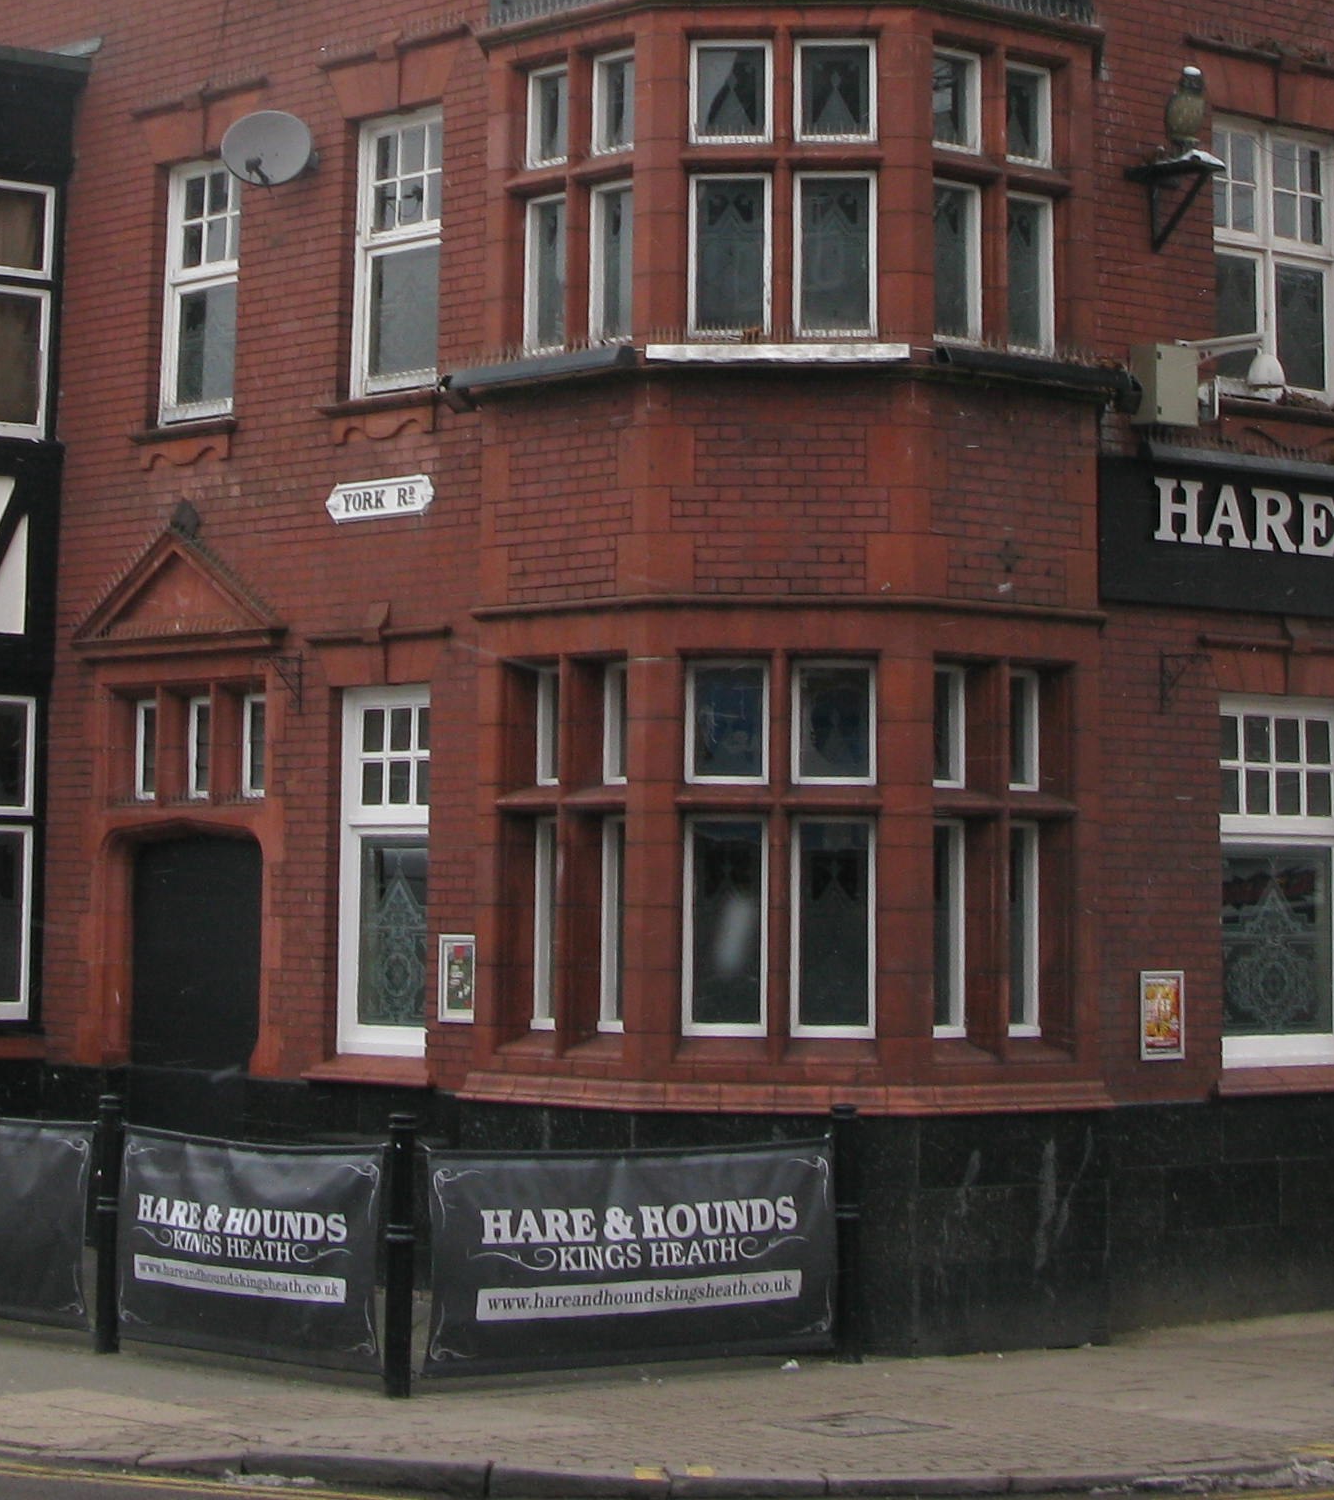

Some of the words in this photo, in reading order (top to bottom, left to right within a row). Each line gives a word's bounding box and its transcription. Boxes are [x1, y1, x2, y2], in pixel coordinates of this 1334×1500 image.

[342, 489, 386, 512] YORK
[137, 1193, 202, 1230] HARE
[203, 1204, 223, 1231] &
[223, 1207, 348, 1243] HOUNDS
[480, 1208, 597, 1244] HARE
[603, 1206, 636, 1241] &
[639, 1195, 798, 1239] HOUNDS
[172, 1229, 222, 1256] KINGS
[227, 1238, 292, 1262] HEATH
[559, 1245, 642, 1272] KINGS
[649, 1237, 739, 1268] HEATH
[138, 1262, 338, 1296] www.hareandhoundskingsheath.co.uk
[488, 1276, 793, 1311] www.hareandhoundskingsheath.co.uk
